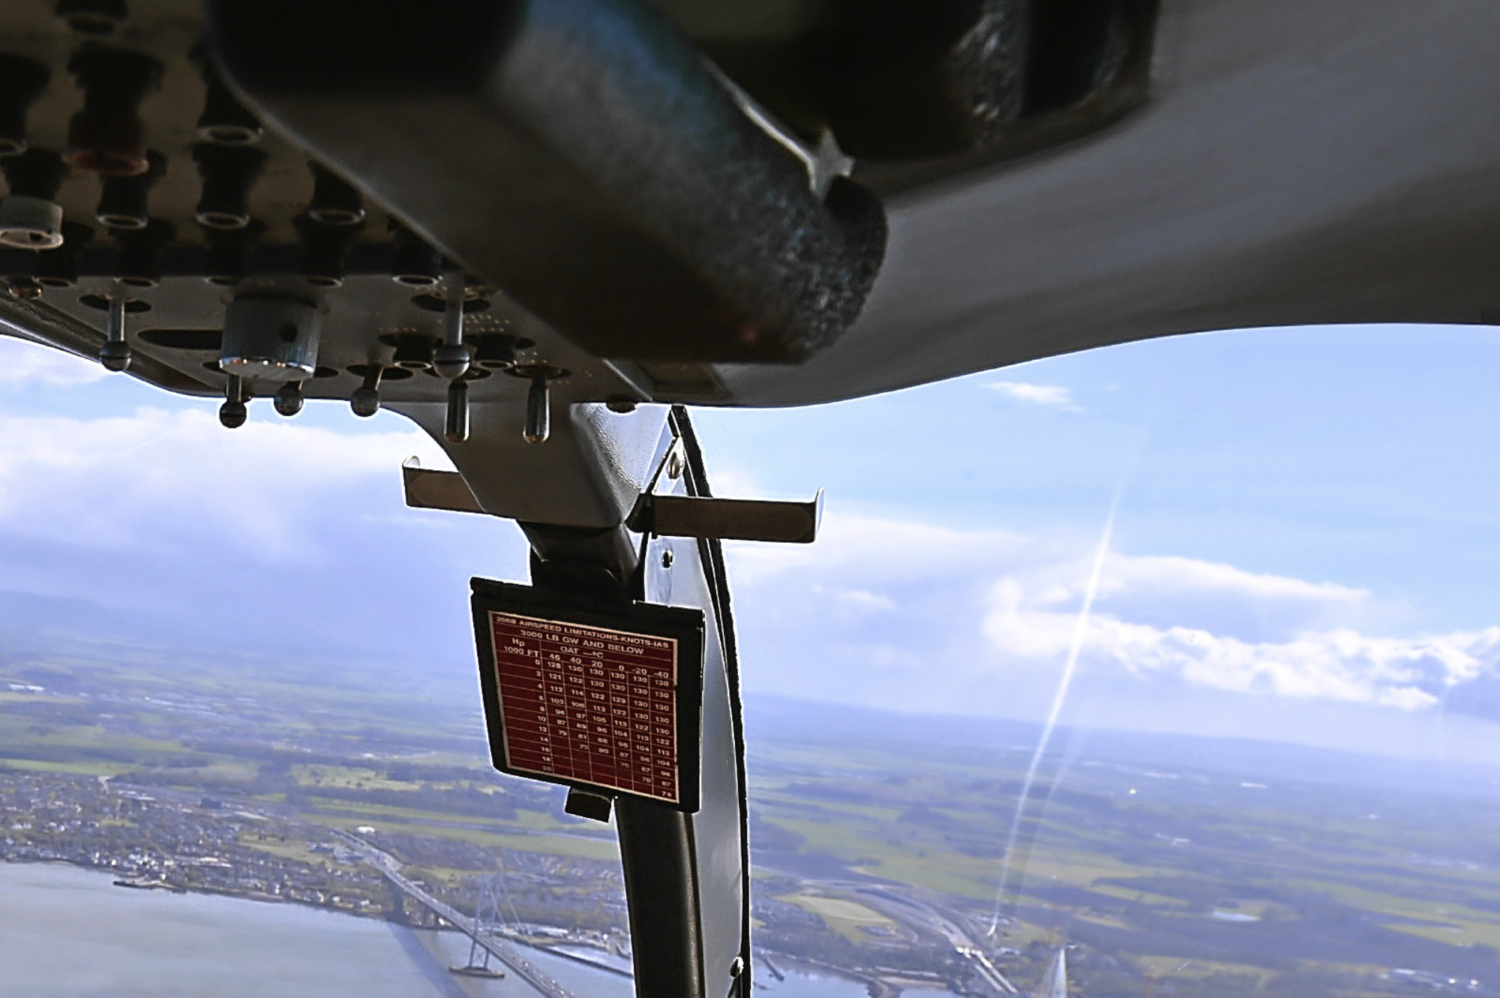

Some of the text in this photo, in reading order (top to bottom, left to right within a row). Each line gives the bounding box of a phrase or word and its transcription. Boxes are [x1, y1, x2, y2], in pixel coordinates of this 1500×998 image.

[519, 619, 562, 632] AIRSPEED
[503, 645, 539, 658] 1000 FT
[520, 629, 644, 655] 3000 LB GW AND BELOW
[570, 657, 582, 665] 40
[591, 660, 603, 669] 20
[632, 667, 648, 676] -20
[653, 671, 669, 679] -40
[548, 672, 562, 681] 121
[590, 680, 604, 688] 130
[611, 683, 626, 692] 130
[633, 687, 648, 696] 130
[655, 690, 669, 699] 130
